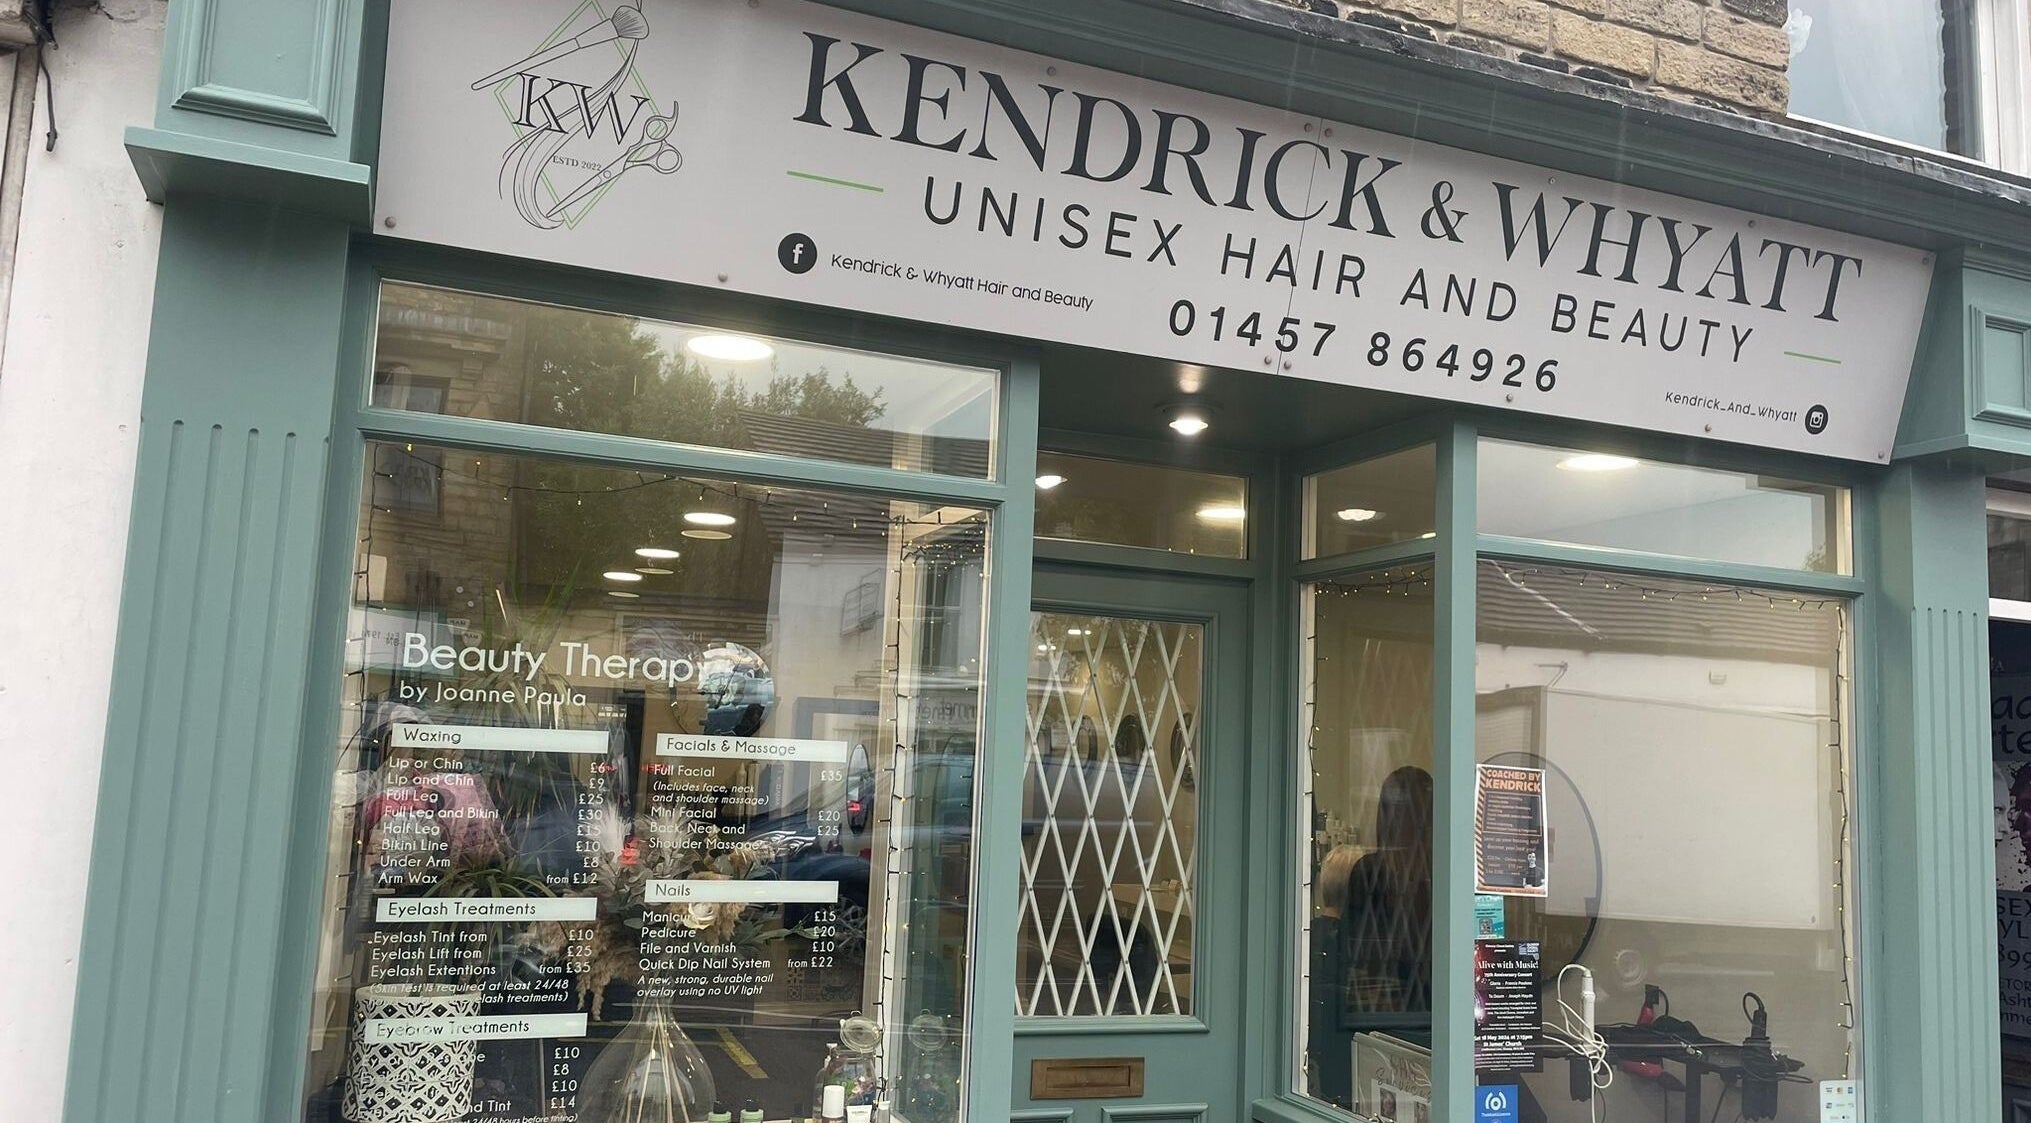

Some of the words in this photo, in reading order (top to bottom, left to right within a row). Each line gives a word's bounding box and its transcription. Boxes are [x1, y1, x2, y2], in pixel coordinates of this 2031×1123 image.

[512, 71, 650, 145] KW
[552, 155, 579, 168] ESTD
[581, 158, 602, 171] 2022
[793, 31, 1402, 238] KENDRICK
[1420, 180, 1469, 243] &
[1492, 181, 1863, 322] WHYATT
[924, 176, 1184, 267] UNISEX
[1221, 232, 1365, 298] HAIR
[1400, 267, 1518, 323] AND
[1551, 293, 1754, 363] BEAUTY
[831, 253, 902, 278] Kendrick
[906, 267, 919, 280] &
[923, 268, 975, 290] Whyatt
[977, 278, 1009, 295] Hair
[1011, 287, 1042, 302] and
[1044, 290, 1094, 312] Beauty
[1169, 298, 1337, 358] 01457
[1366, 331, 1560, 393] 864926
[1665, 391, 1798, 424] Kendrick_And_Whyatt
[402, 632, 546, 681] Beauty
[399, 680, 428, 703] by
[434, 681, 515, 704] Joanne
[524, 687, 587, 708] Paula
[404, 728, 462, 744] Waxing
[667, 738, 716, 752] Facials
[721, 740, 731, 753] &
[735, 740, 796, 756] Massage
[389, 757, 409, 770] Lip
[414, 759, 428, 768] or
[433, 757, 463, 770] Chin
[590, 762, 606, 773] £6
[654, 764, 674, 776] Full
[678, 764, 715, 777] Facial
[820, 770, 843, 781] £35
[387, 774, 408, 787] Lip
[412, 774, 440, 786] and
[444, 774, 474, 786] Chin
[589, 777, 605, 789] £9
[1486, 769, 1527, 780] COACHED
[1528, 772, 1541, 781] BY
[652, 781, 700, 792] (Includes
[702, 783, 728, 794] face,
[731, 784, 755, 794] neck
[1484, 778, 1541, 793] KENDRICK
[386, 789, 410, 801] Full
[413, 789, 438, 804] Leg
[578, 793, 604, 805] £25
[652, 793, 674, 803] and
[675, 793, 719, 804] shoulder
[721, 795, 770, 807] massage)
[384, 806, 408, 818] Full
[410, 806, 434, 820] Leg
[437, 807, 465, 819] and
[467, 808, 500, 819] Bikini
[578, 809, 603, 820] £30
[650, 806, 675, 818] Mini
[679, 807, 717, 819] Facial
[818, 810, 841, 822] £20
[383, 821, 411, 834] Half
[414, 823, 440, 836] Leg
[687, 823, 718, 835] Neck
[721, 823, 746, 835] and
[817, 826, 840, 837] £25
[381, 838, 417, 851] Bikini
[420, 839, 448, 851] Line
[575, 841, 600, 852] £10
[648, 837, 703, 850] Shoulder
[706, 838, 759, 852] Massage
[380, 855, 424, 868] Under
[426, 856, 451, 868] Arm
[583, 857, 600, 868] £8
[377, 872, 403, 884] Arm
[407, 873, 438, 884] Wax
[546, 874, 569, 884] from
[573, 872, 599, 884] £12
[655, 883, 691, 898] Nails
[388, 901, 448, 918] Eyelash
[454, 901, 536, 916] Treatments
[642, 910, 692, 923] Manicur
[814, 911, 837, 922] £15
[373, 931, 426, 945] Eyelash
[431, 930, 456, 943] Tint
[459, 931, 488, 943] from
[568, 929, 594, 941] £10
[641, 926, 697, 939] Pedicure
[813, 926, 836, 937] £20
[372, 947, 425, 961] Eyelash
[429, 947, 452, 959] Lift
[453, 948, 482, 959] from
[567, 945, 592, 957] £25
[640, 942, 662, 954] File
[665, 942, 689, 954] and
[693, 942, 737, 954] Varnish
[812, 941, 835, 953] £10
[371, 964, 423, 978] Eyelash
[428, 964, 496, 976] Extentions
[538, 964, 562, 975] from
[566, 961, 591, 973] £35
[639, 958, 674, 971] Quick
[678, 958, 699, 971] Dip
[703, 957, 728, 969] Nail
[731, 957, 771, 971] System
[787, 958, 808, 968] from
[811, 957, 833, 968] £22
[1478, 960, 1496, 969] Alive
[1497, 960, 1514, 969] with
[1515, 960, 1539, 969] Music!
[436, 980, 485, 994] required
[488, 981, 501, 992] at
[503, 980, 532, 992] least
[533, 979, 570, 990] 24/48
[637, 976, 646, 985] A
[648, 976, 672, 986] new,
[674, 975, 709, 986] strong,
[712, 973, 752, 984] durable
[754, 973, 774, 983] nail
[506, 991, 569, 1004] treatments)
[637, 985, 677, 998] overlay
[679, 986, 706, 998] using
[707, 988, 721, 996] no
[724, 985, 740, 996] UV
[741, 985, 763, 997] light
[376, 1022, 444, 1038] Eyebrow
[448, 1019, 529, 1035] Treatments
[554, 1047, 580, 1060] £10
[553, 1063, 570, 1076] £8
[552, 1080, 577, 1093] £10
[487, 1099, 511, 1113] Tint
[551, 1094, 576, 1109] £14
